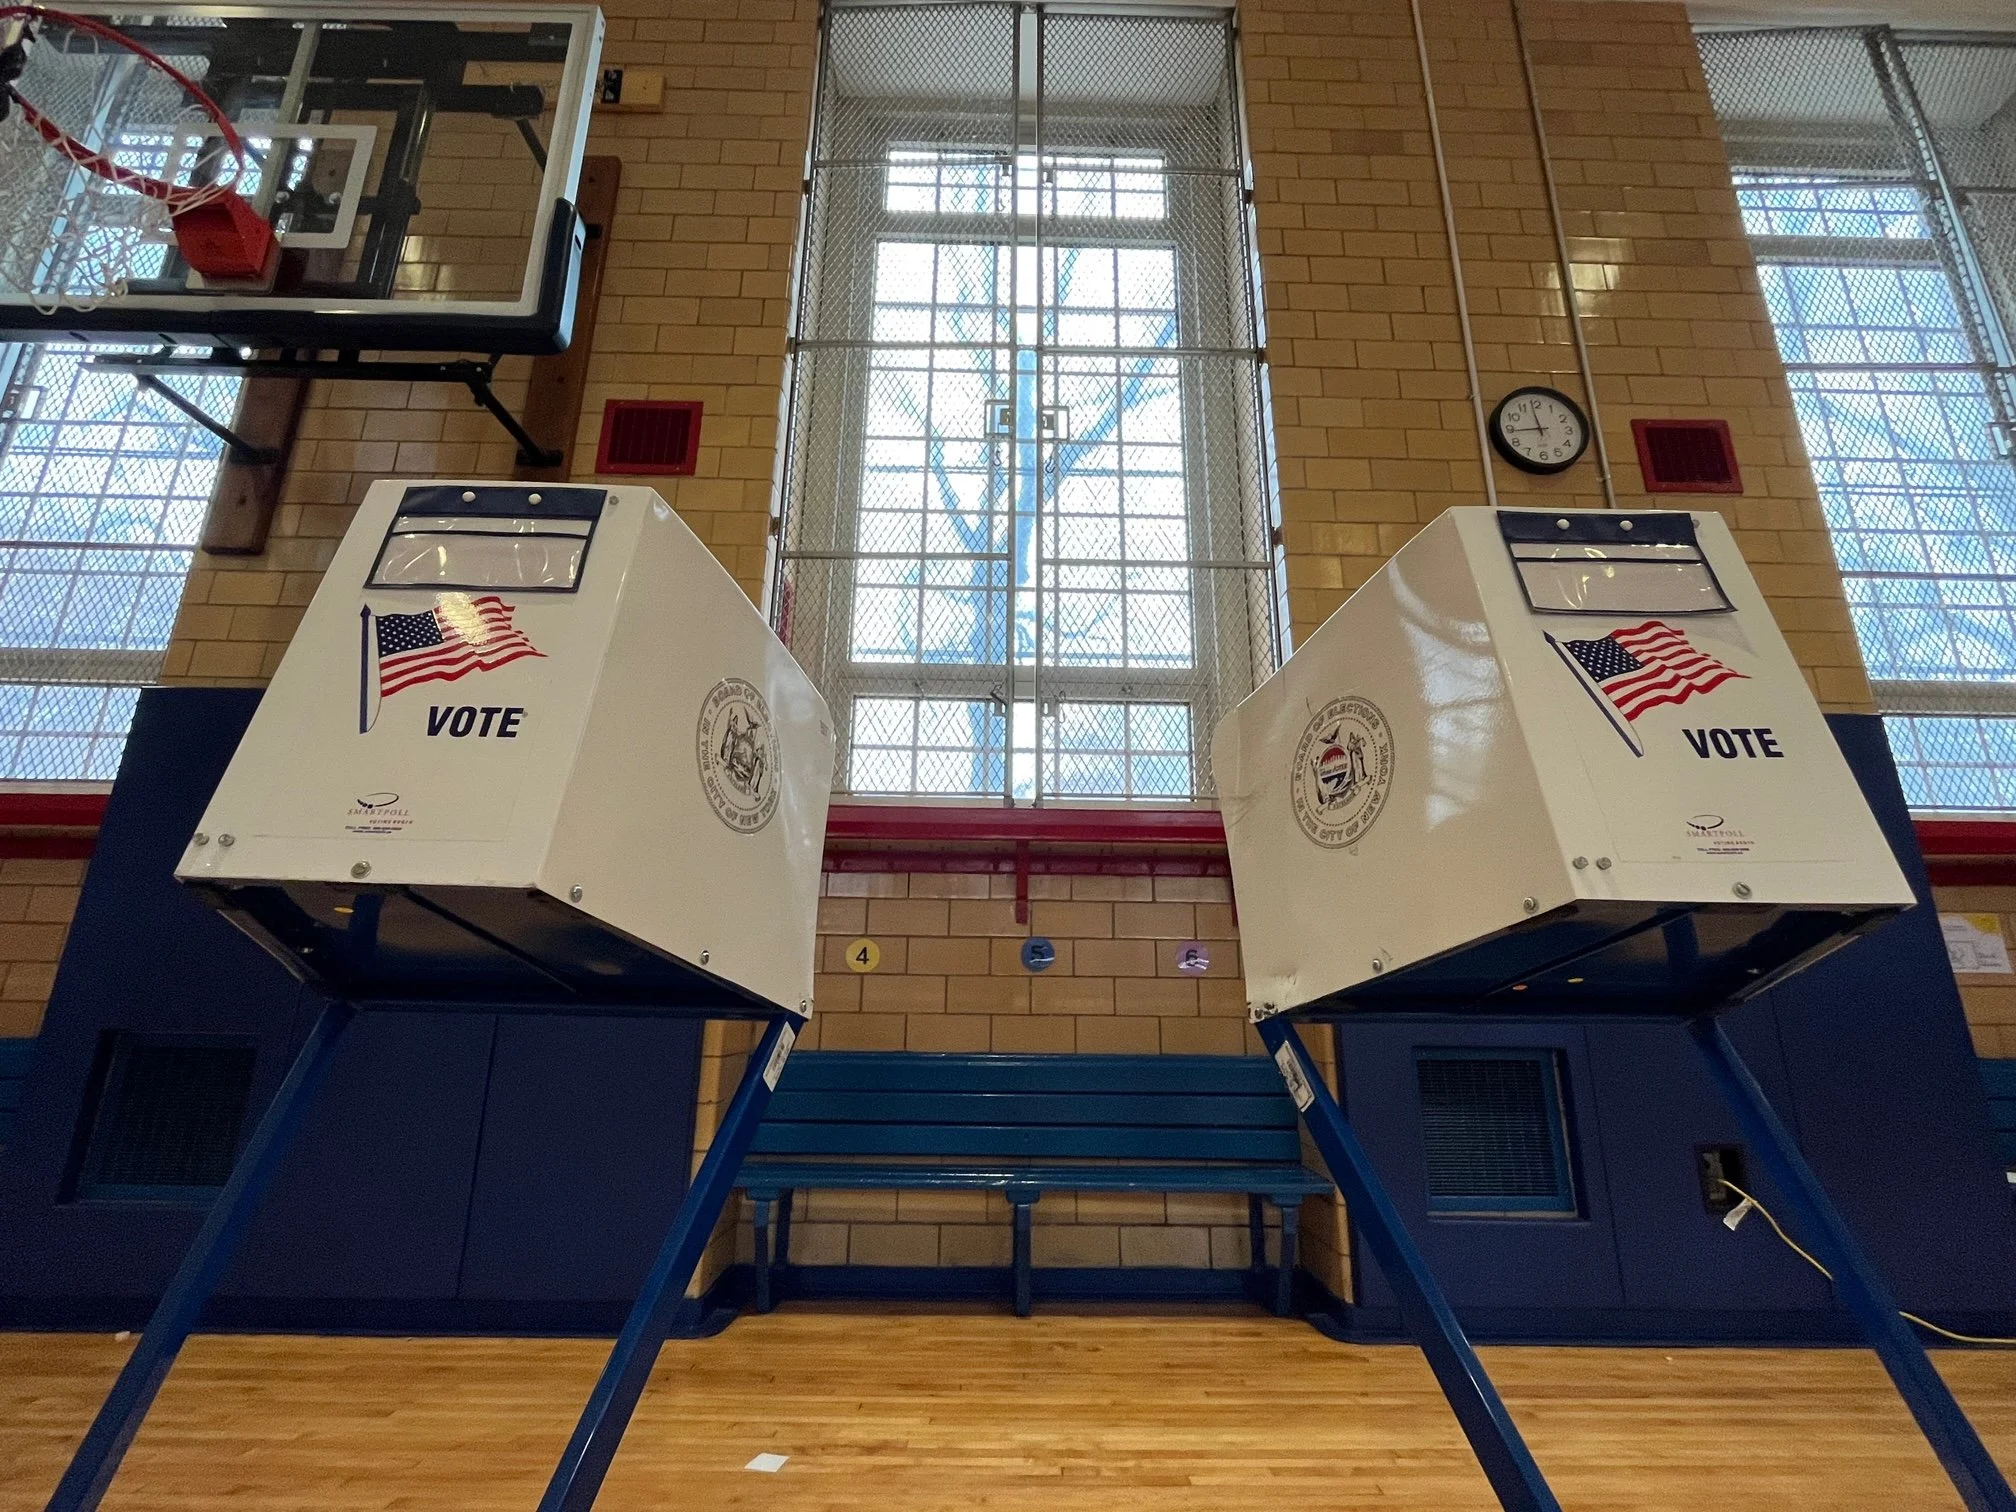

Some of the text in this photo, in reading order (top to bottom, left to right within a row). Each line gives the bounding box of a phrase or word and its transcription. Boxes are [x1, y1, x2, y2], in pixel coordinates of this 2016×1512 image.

[1519, 404, 1527, 412] 11
[1530, 401, 1541, 409] 2
[1549, 404, 1553, 413] 1
[1508, 412, 1520, 422] 10
[1559, 414, 1568, 424] 2
[1505, 424, 1514, 434] 9
[1564, 426, 1573, 435] 3
[1512, 438, 1520, 447] 8
[1523, 448, 1531, 456] 7
[1540, 451, 1548, 460] 6
[1554, 448, 1563, 457] 5
[1327, 702, 1380, 730] ELECTIONS
[427, 706, 524, 737] VOTE
[1682, 728, 1784, 759] VOTE
[1319, 828, 1344, 842] CITY
[1345, 821, 1360, 837] OF
[855, 946, 870, 965] 4
[1031, 945, 1045, 963] 5
[1186, 949, 1199, 967] 6
